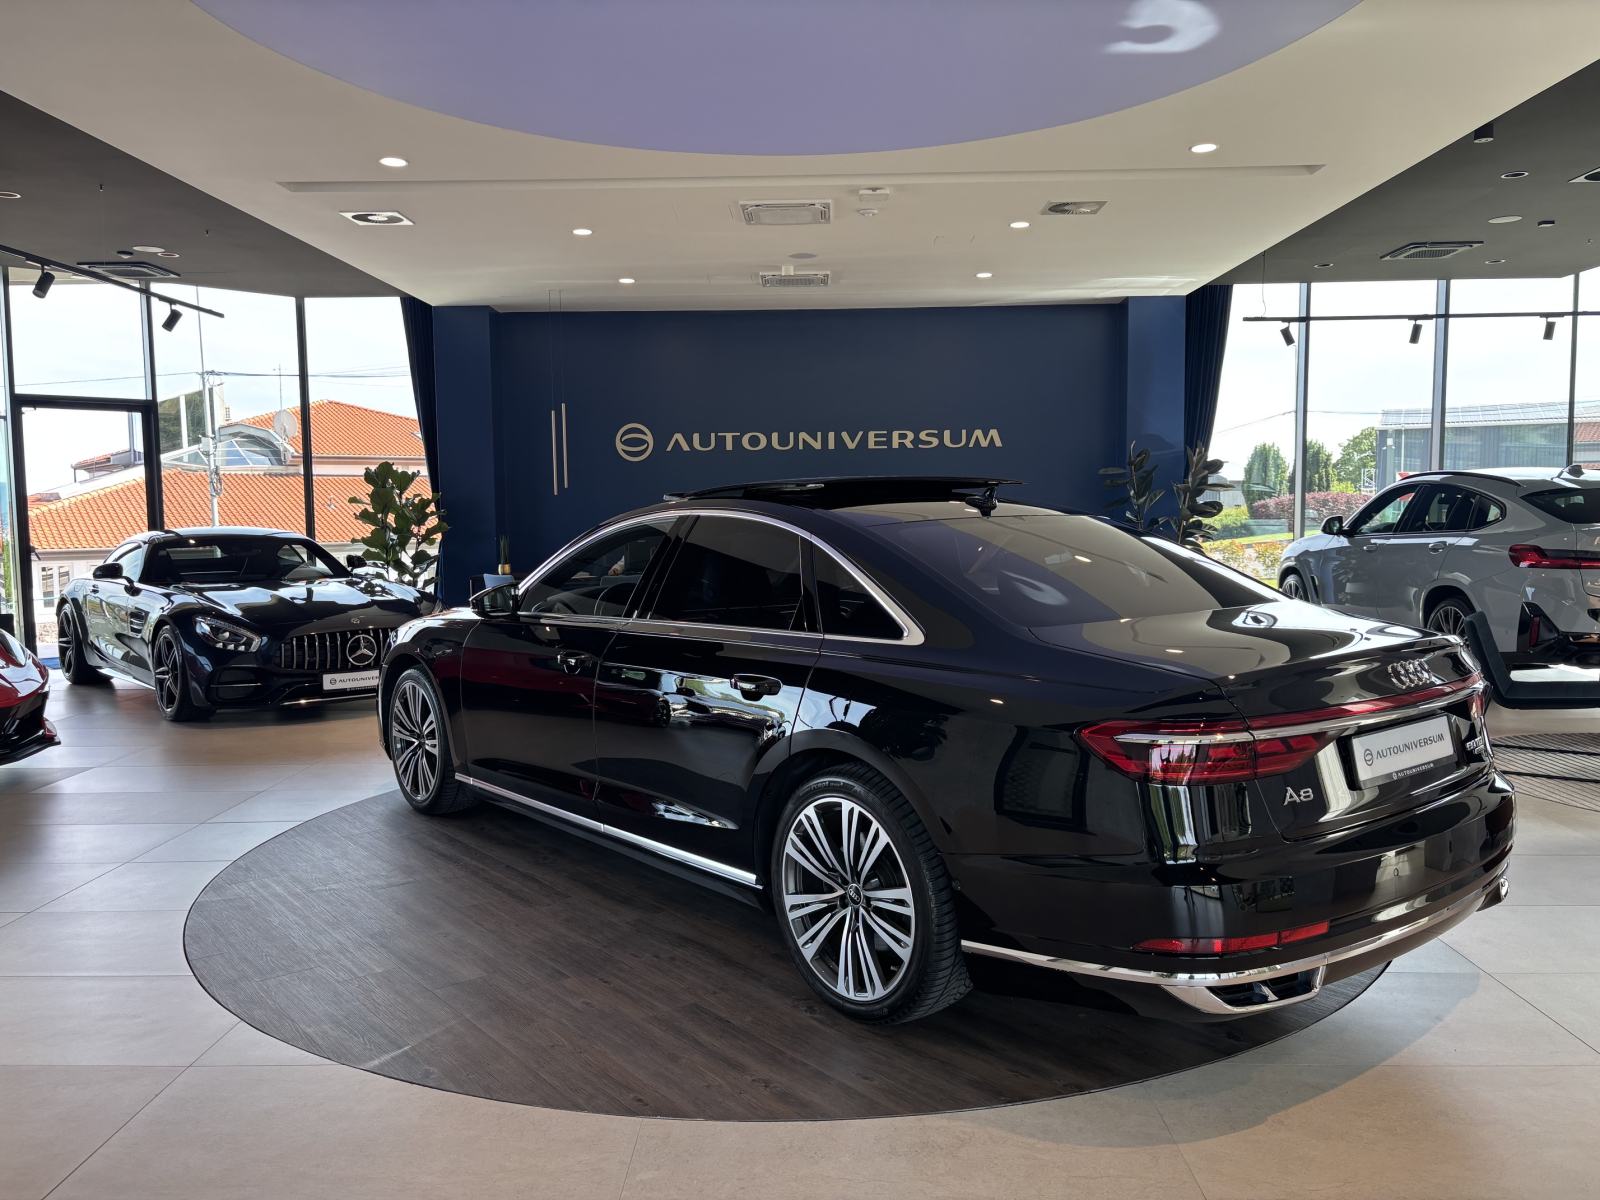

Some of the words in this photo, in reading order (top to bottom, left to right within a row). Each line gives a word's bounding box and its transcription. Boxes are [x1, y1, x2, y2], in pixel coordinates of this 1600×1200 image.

[666, 428, 1003, 452] AUTOUNIVERSUM
[1376, 733, 1445, 760] AUTOUNIVERSUM
[1283, 786, 1314, 806] A8
